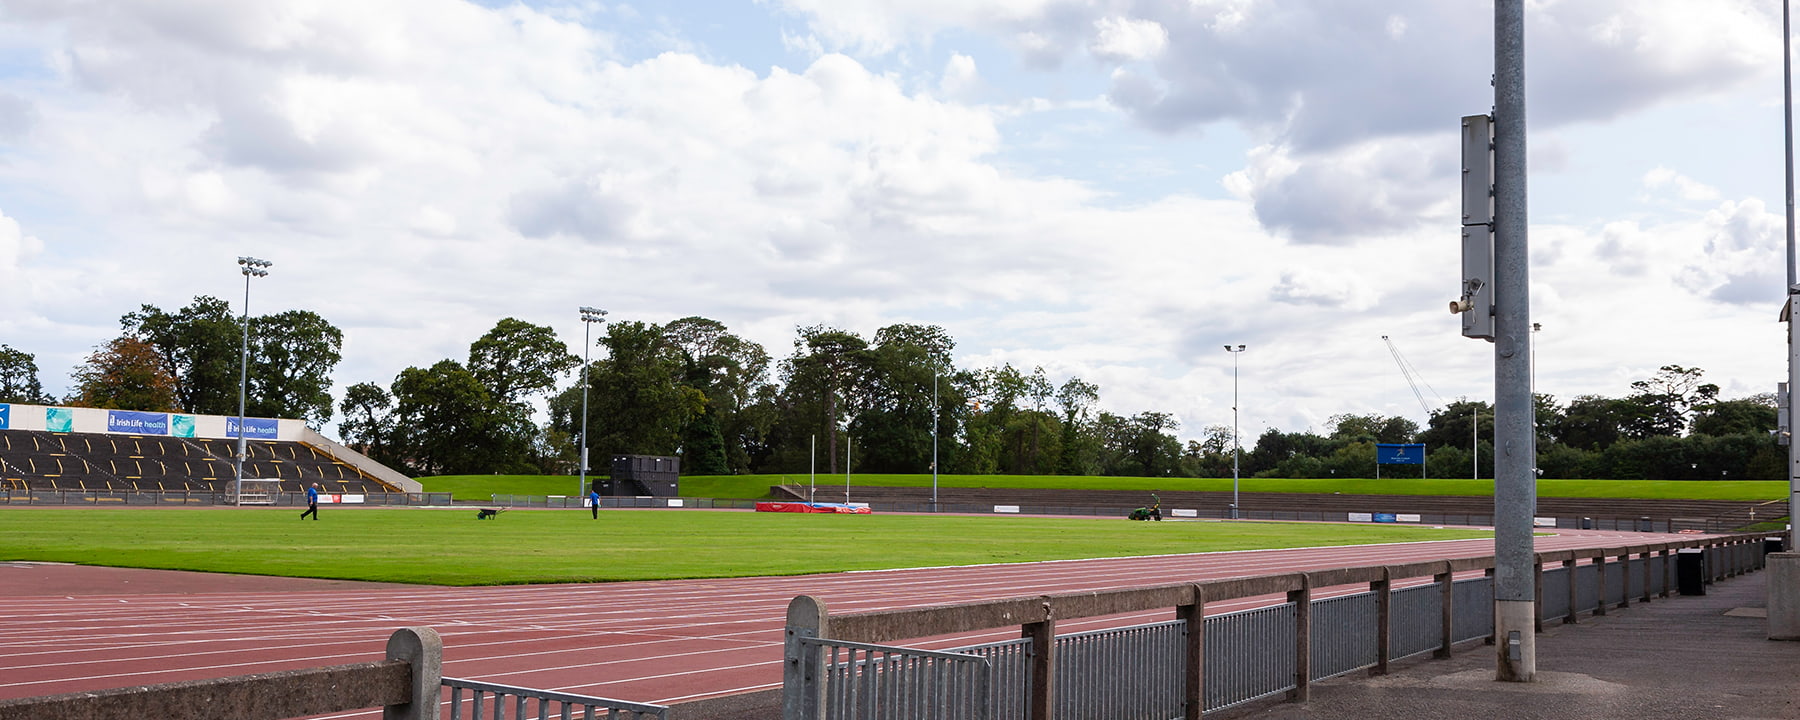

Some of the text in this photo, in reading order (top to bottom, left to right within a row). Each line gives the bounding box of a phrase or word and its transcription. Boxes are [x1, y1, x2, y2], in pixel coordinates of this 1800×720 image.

[116, 419, 166, 429] Irish Life health
[246, 425, 256, 433] Life
[257, 426, 277, 434] health
